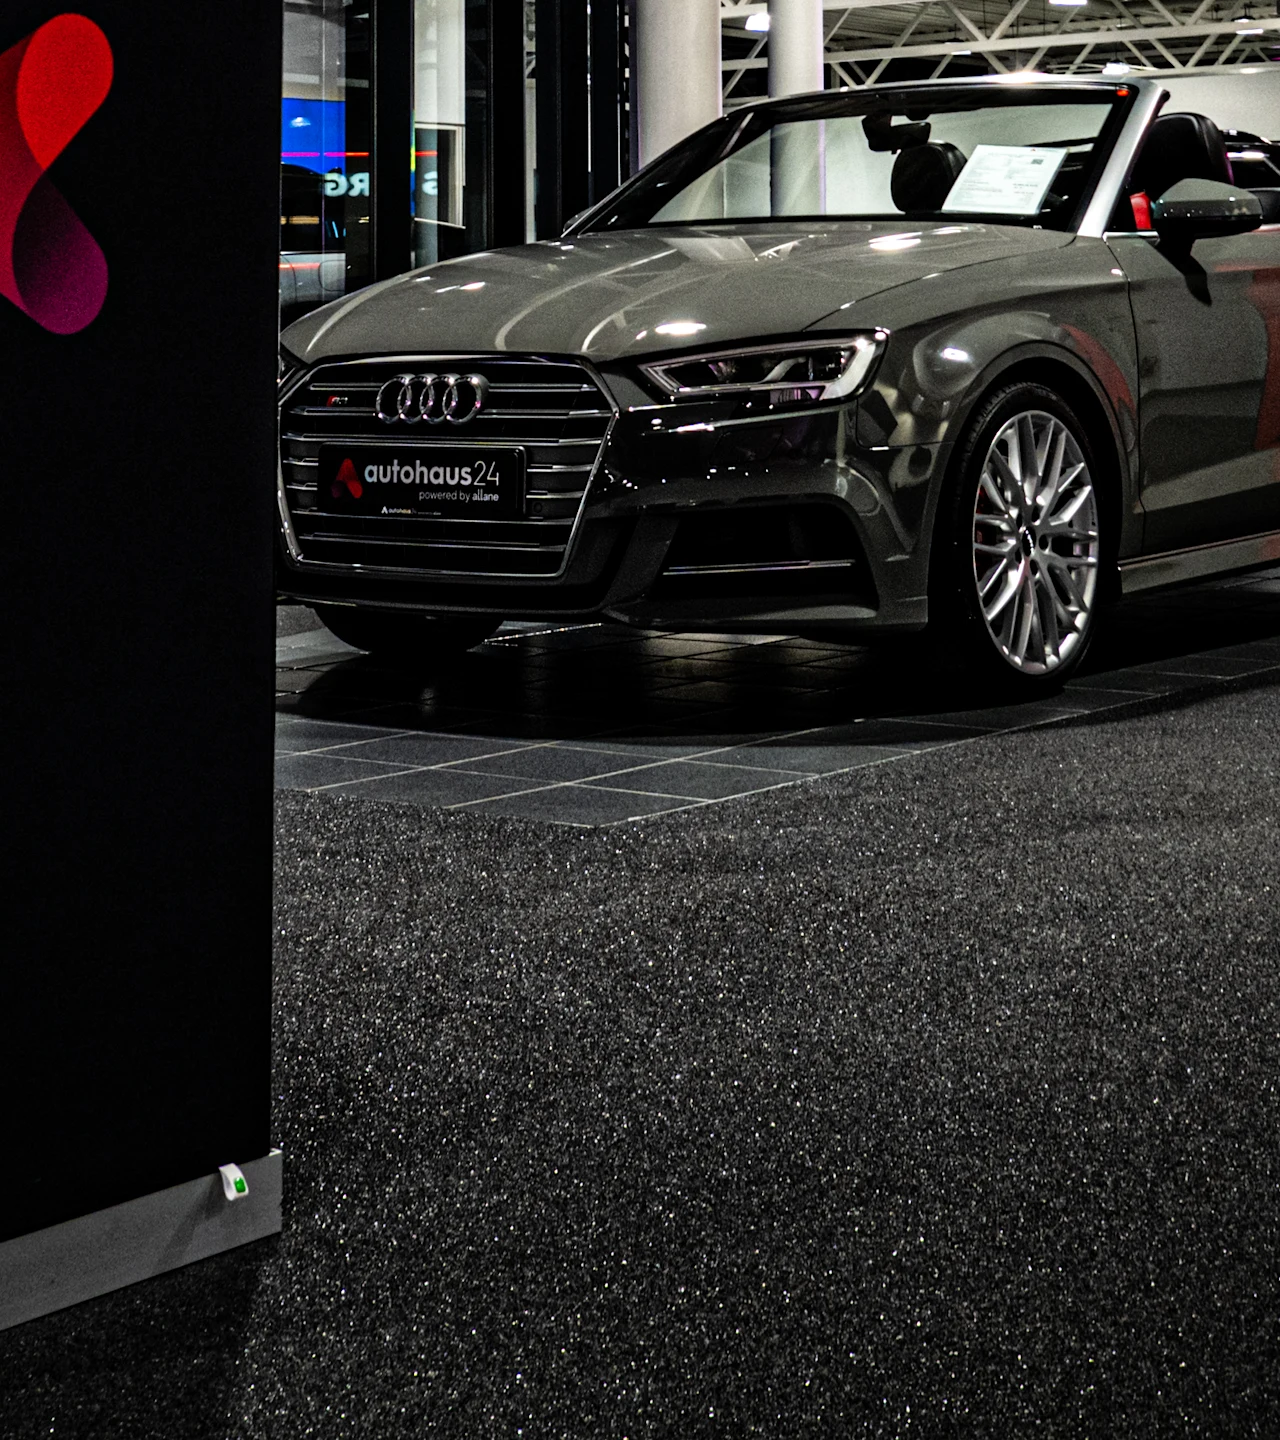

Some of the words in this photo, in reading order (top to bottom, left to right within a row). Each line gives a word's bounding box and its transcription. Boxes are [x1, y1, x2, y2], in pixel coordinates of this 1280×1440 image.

[363, 458, 500, 486] autohaus24
[419, 490, 457, 501] powered
[459, 490, 471, 503] by
[472, 488, 499, 501] allane
